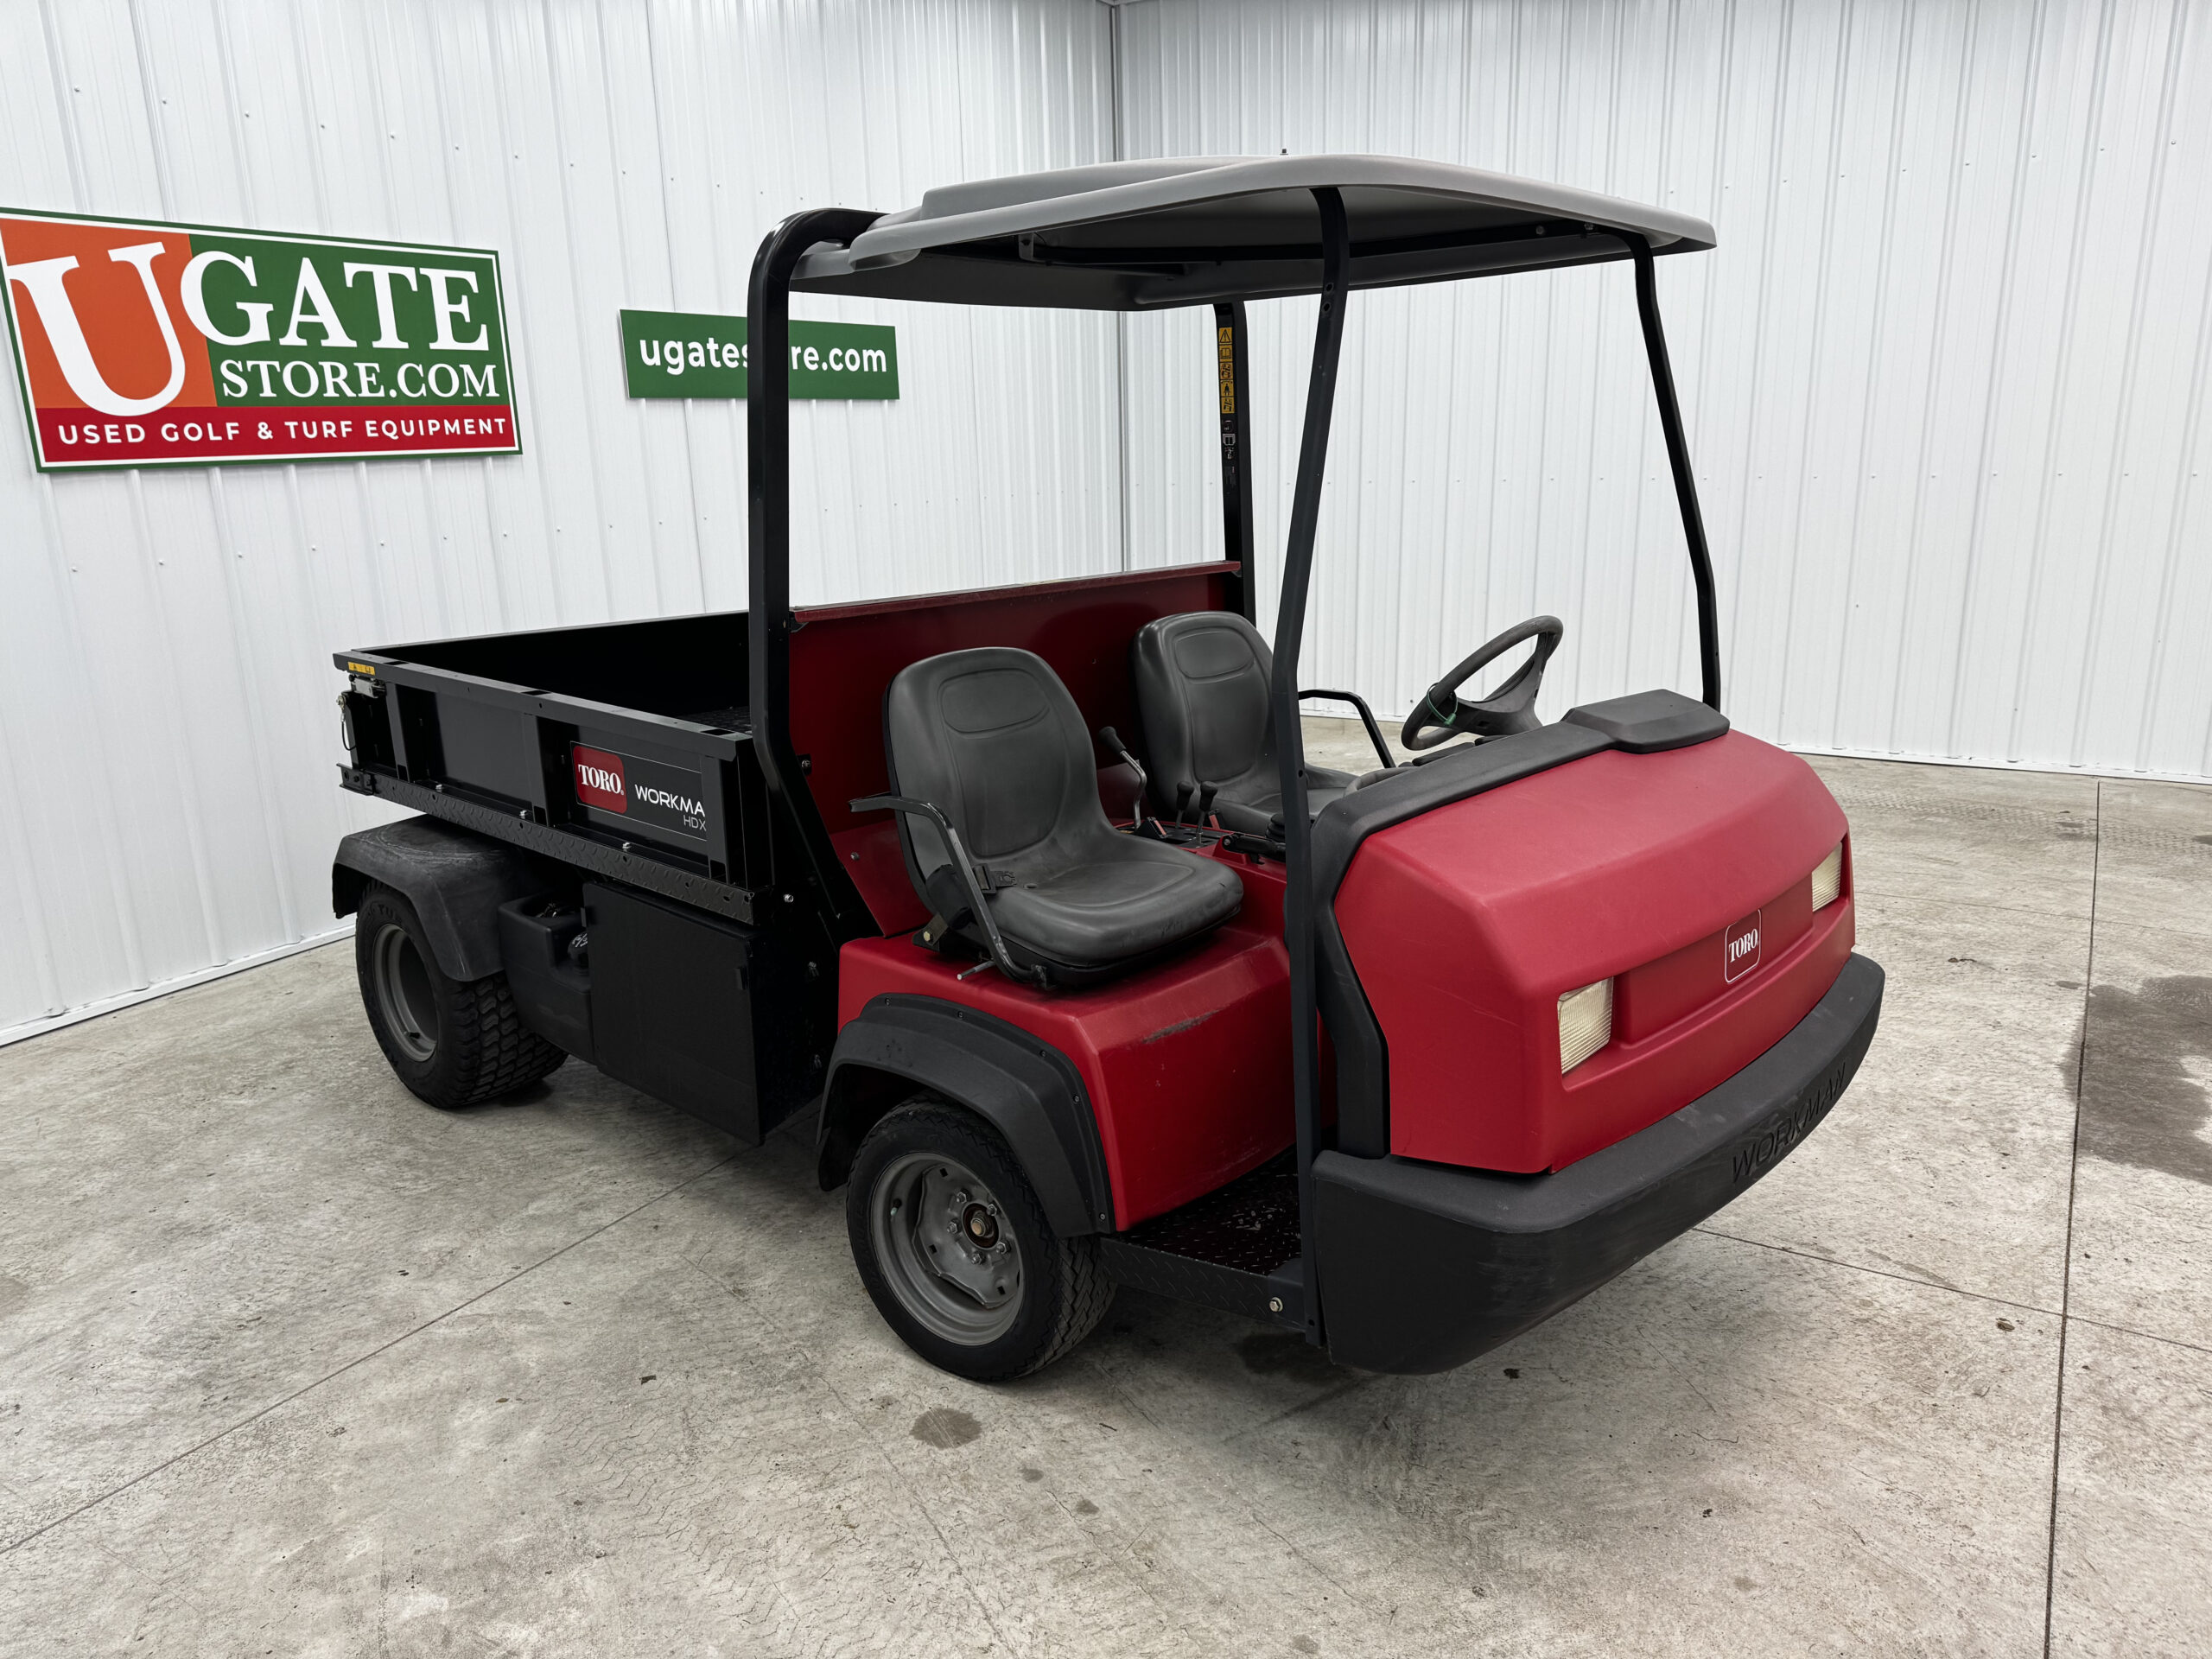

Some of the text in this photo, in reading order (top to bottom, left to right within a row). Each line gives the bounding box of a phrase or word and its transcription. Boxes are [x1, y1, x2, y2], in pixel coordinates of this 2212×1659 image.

[639, 337, 887, 376] ugatere.com
[219, 359, 500, 398] STORE.COM
[58, 417, 506, 444] USED GOLF & TURF EQUIPMENT
[577, 764, 623, 795] TORO
[634, 784, 706, 817] WORKMA
[683, 814, 707, 831] HDX
[1728, 928, 1758, 963] TORO
[1732, 1062, 1846, 1184] WORKMAN
